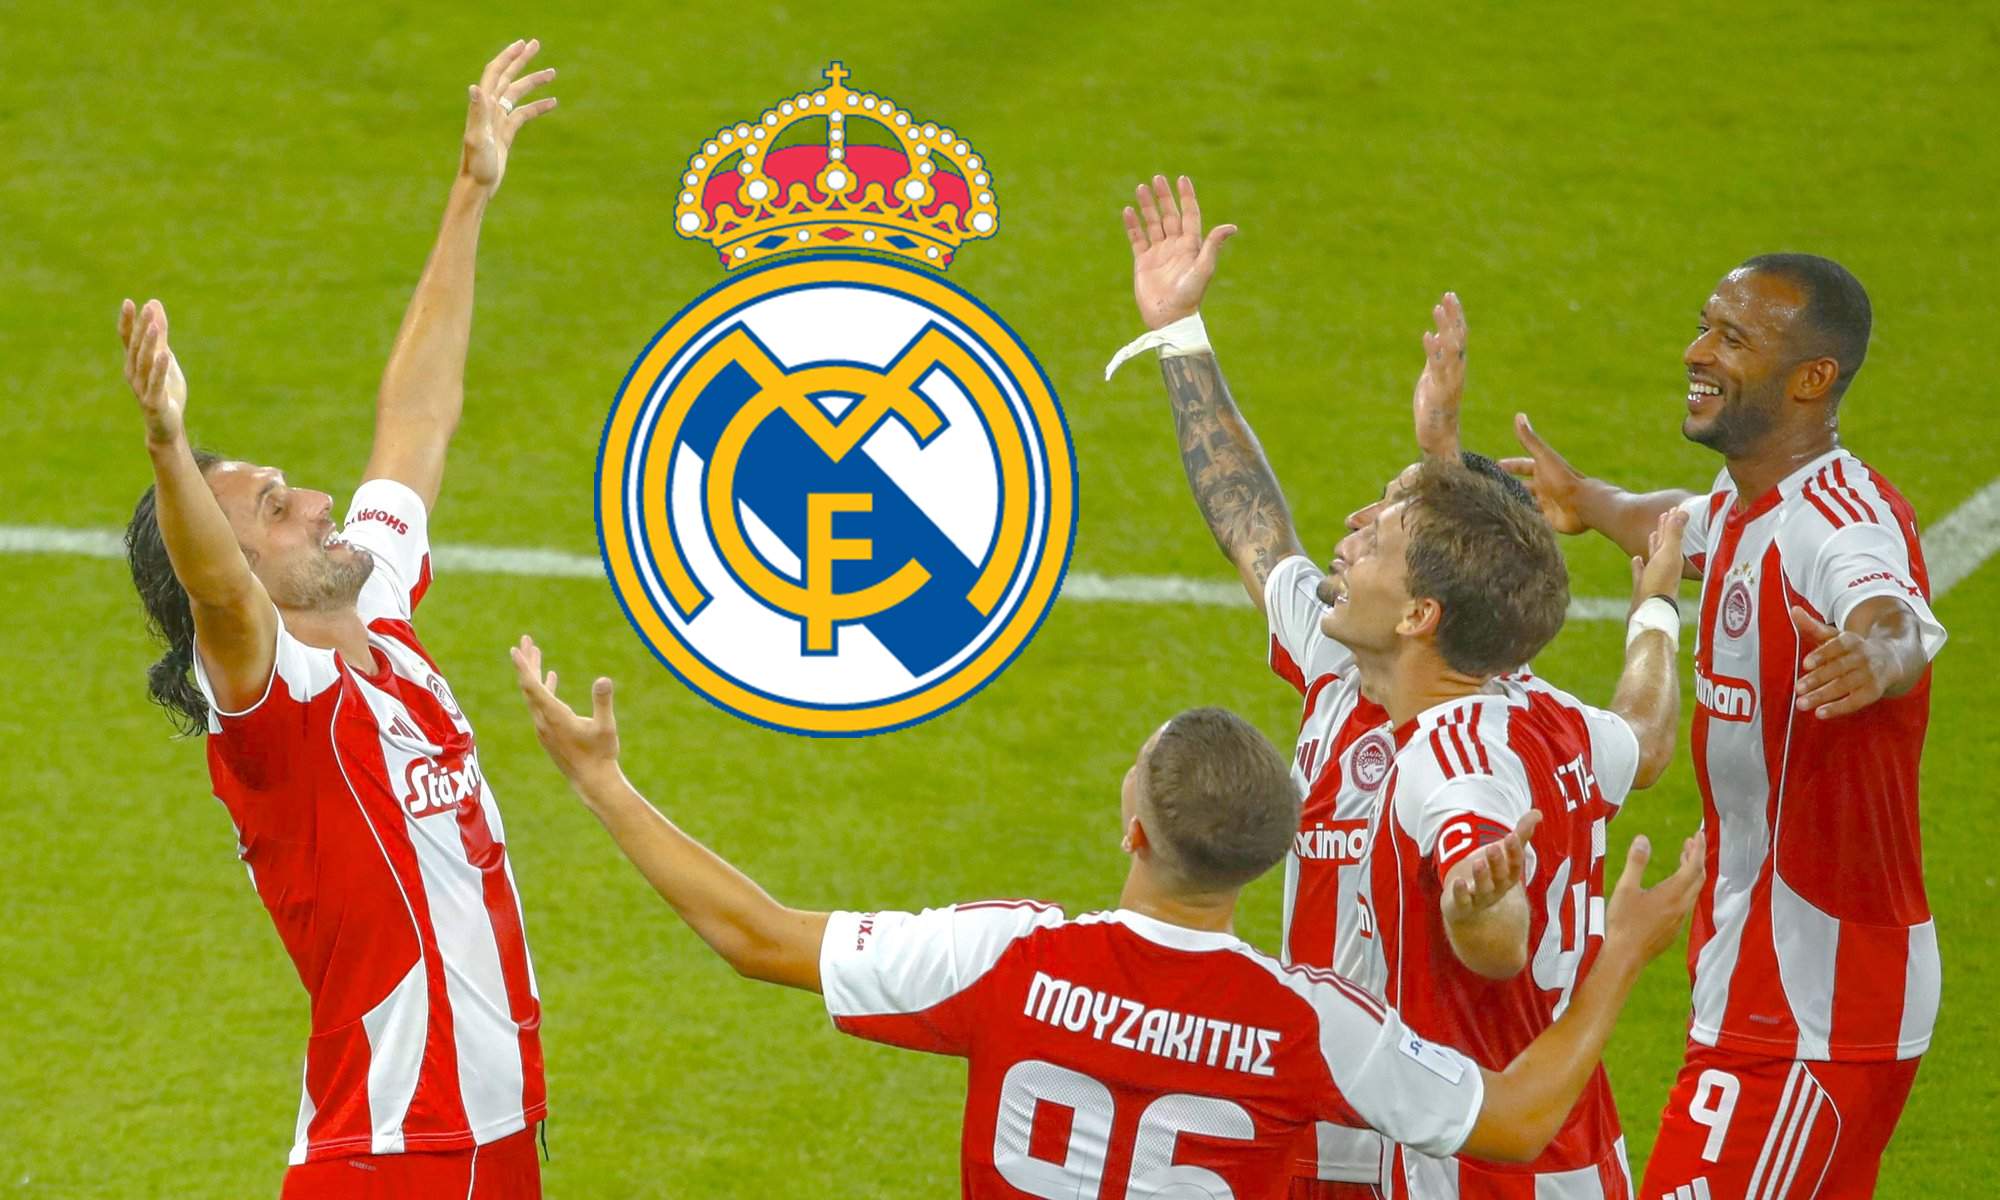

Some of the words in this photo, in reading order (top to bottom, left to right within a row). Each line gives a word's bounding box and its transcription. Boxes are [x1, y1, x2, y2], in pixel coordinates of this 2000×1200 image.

[1438, 821, 1472, 863] C
[1024, 970, 1281, 1077] ΜΟΥΖΑΚΙΤΗΣ
[993, 1059, 1256, 1200] 96
[1689, 1069, 1741, 1163] 9
